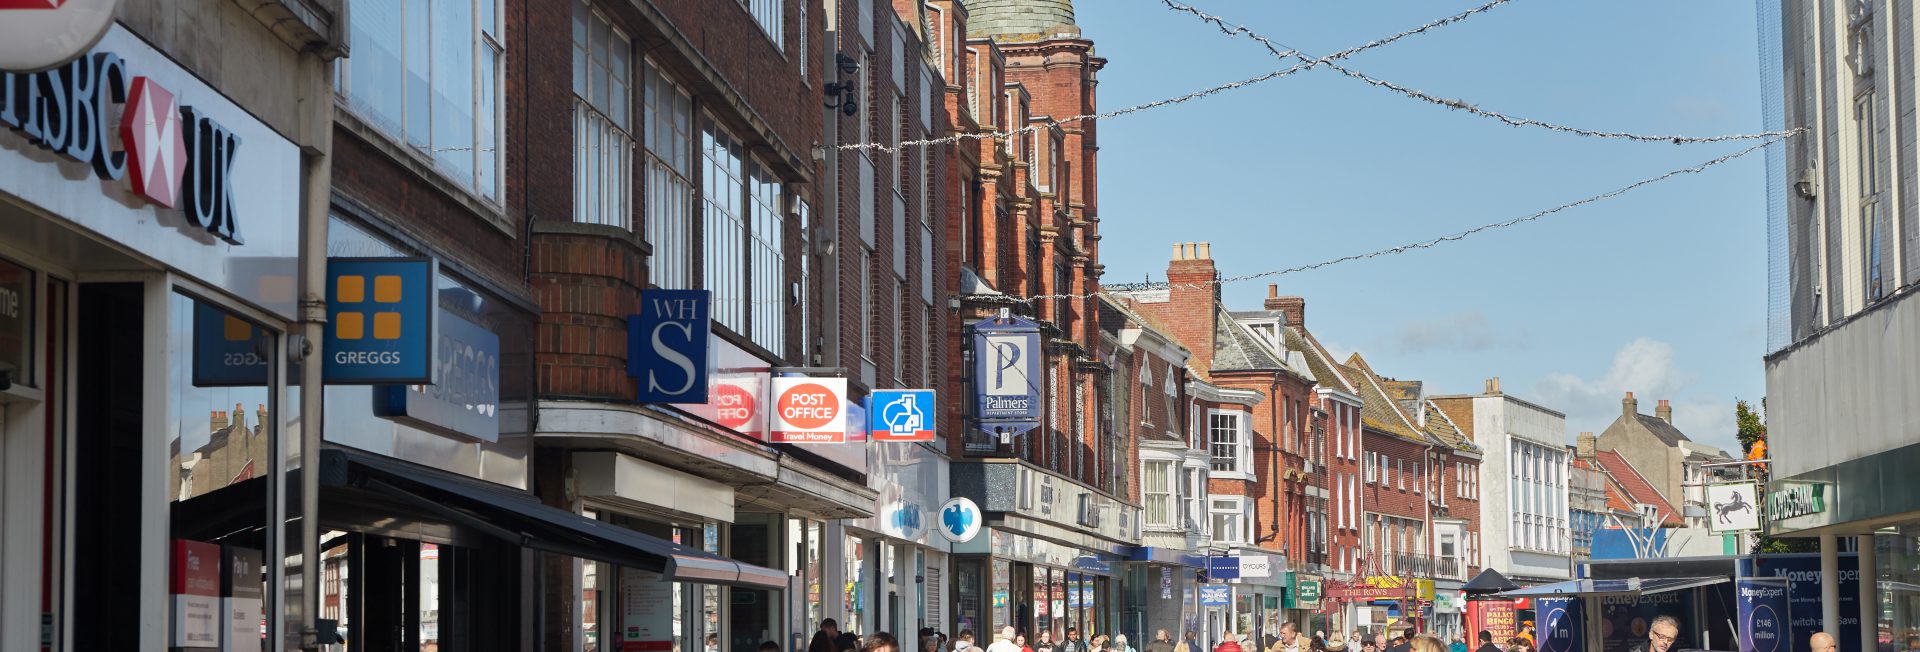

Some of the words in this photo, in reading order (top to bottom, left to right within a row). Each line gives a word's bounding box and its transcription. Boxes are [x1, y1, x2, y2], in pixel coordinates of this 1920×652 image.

[180, 106, 244, 246] UK
[653, 298, 697, 320] WH
[335, 351, 401, 365] GREGGS
[649, 320, 696, 396] S
[995, 341, 1021, 390] P
[791, 393, 826, 406] POST
[986, 396, 1028, 409] Palmers
[784, 407, 833, 420] OFFICE
[783, 431, 805, 441] Travel
[806, 431, 833, 442] Money
[1794, 484, 1815, 517] BANK
[1201, 591, 1228, 599] HALIFAX
[1363, 588, 1388, 596] ROWS
[1741, 587, 1784, 598] MoneyExpert
[1756, 618, 1772, 628] £146
[1754, 630, 1775, 640] million
